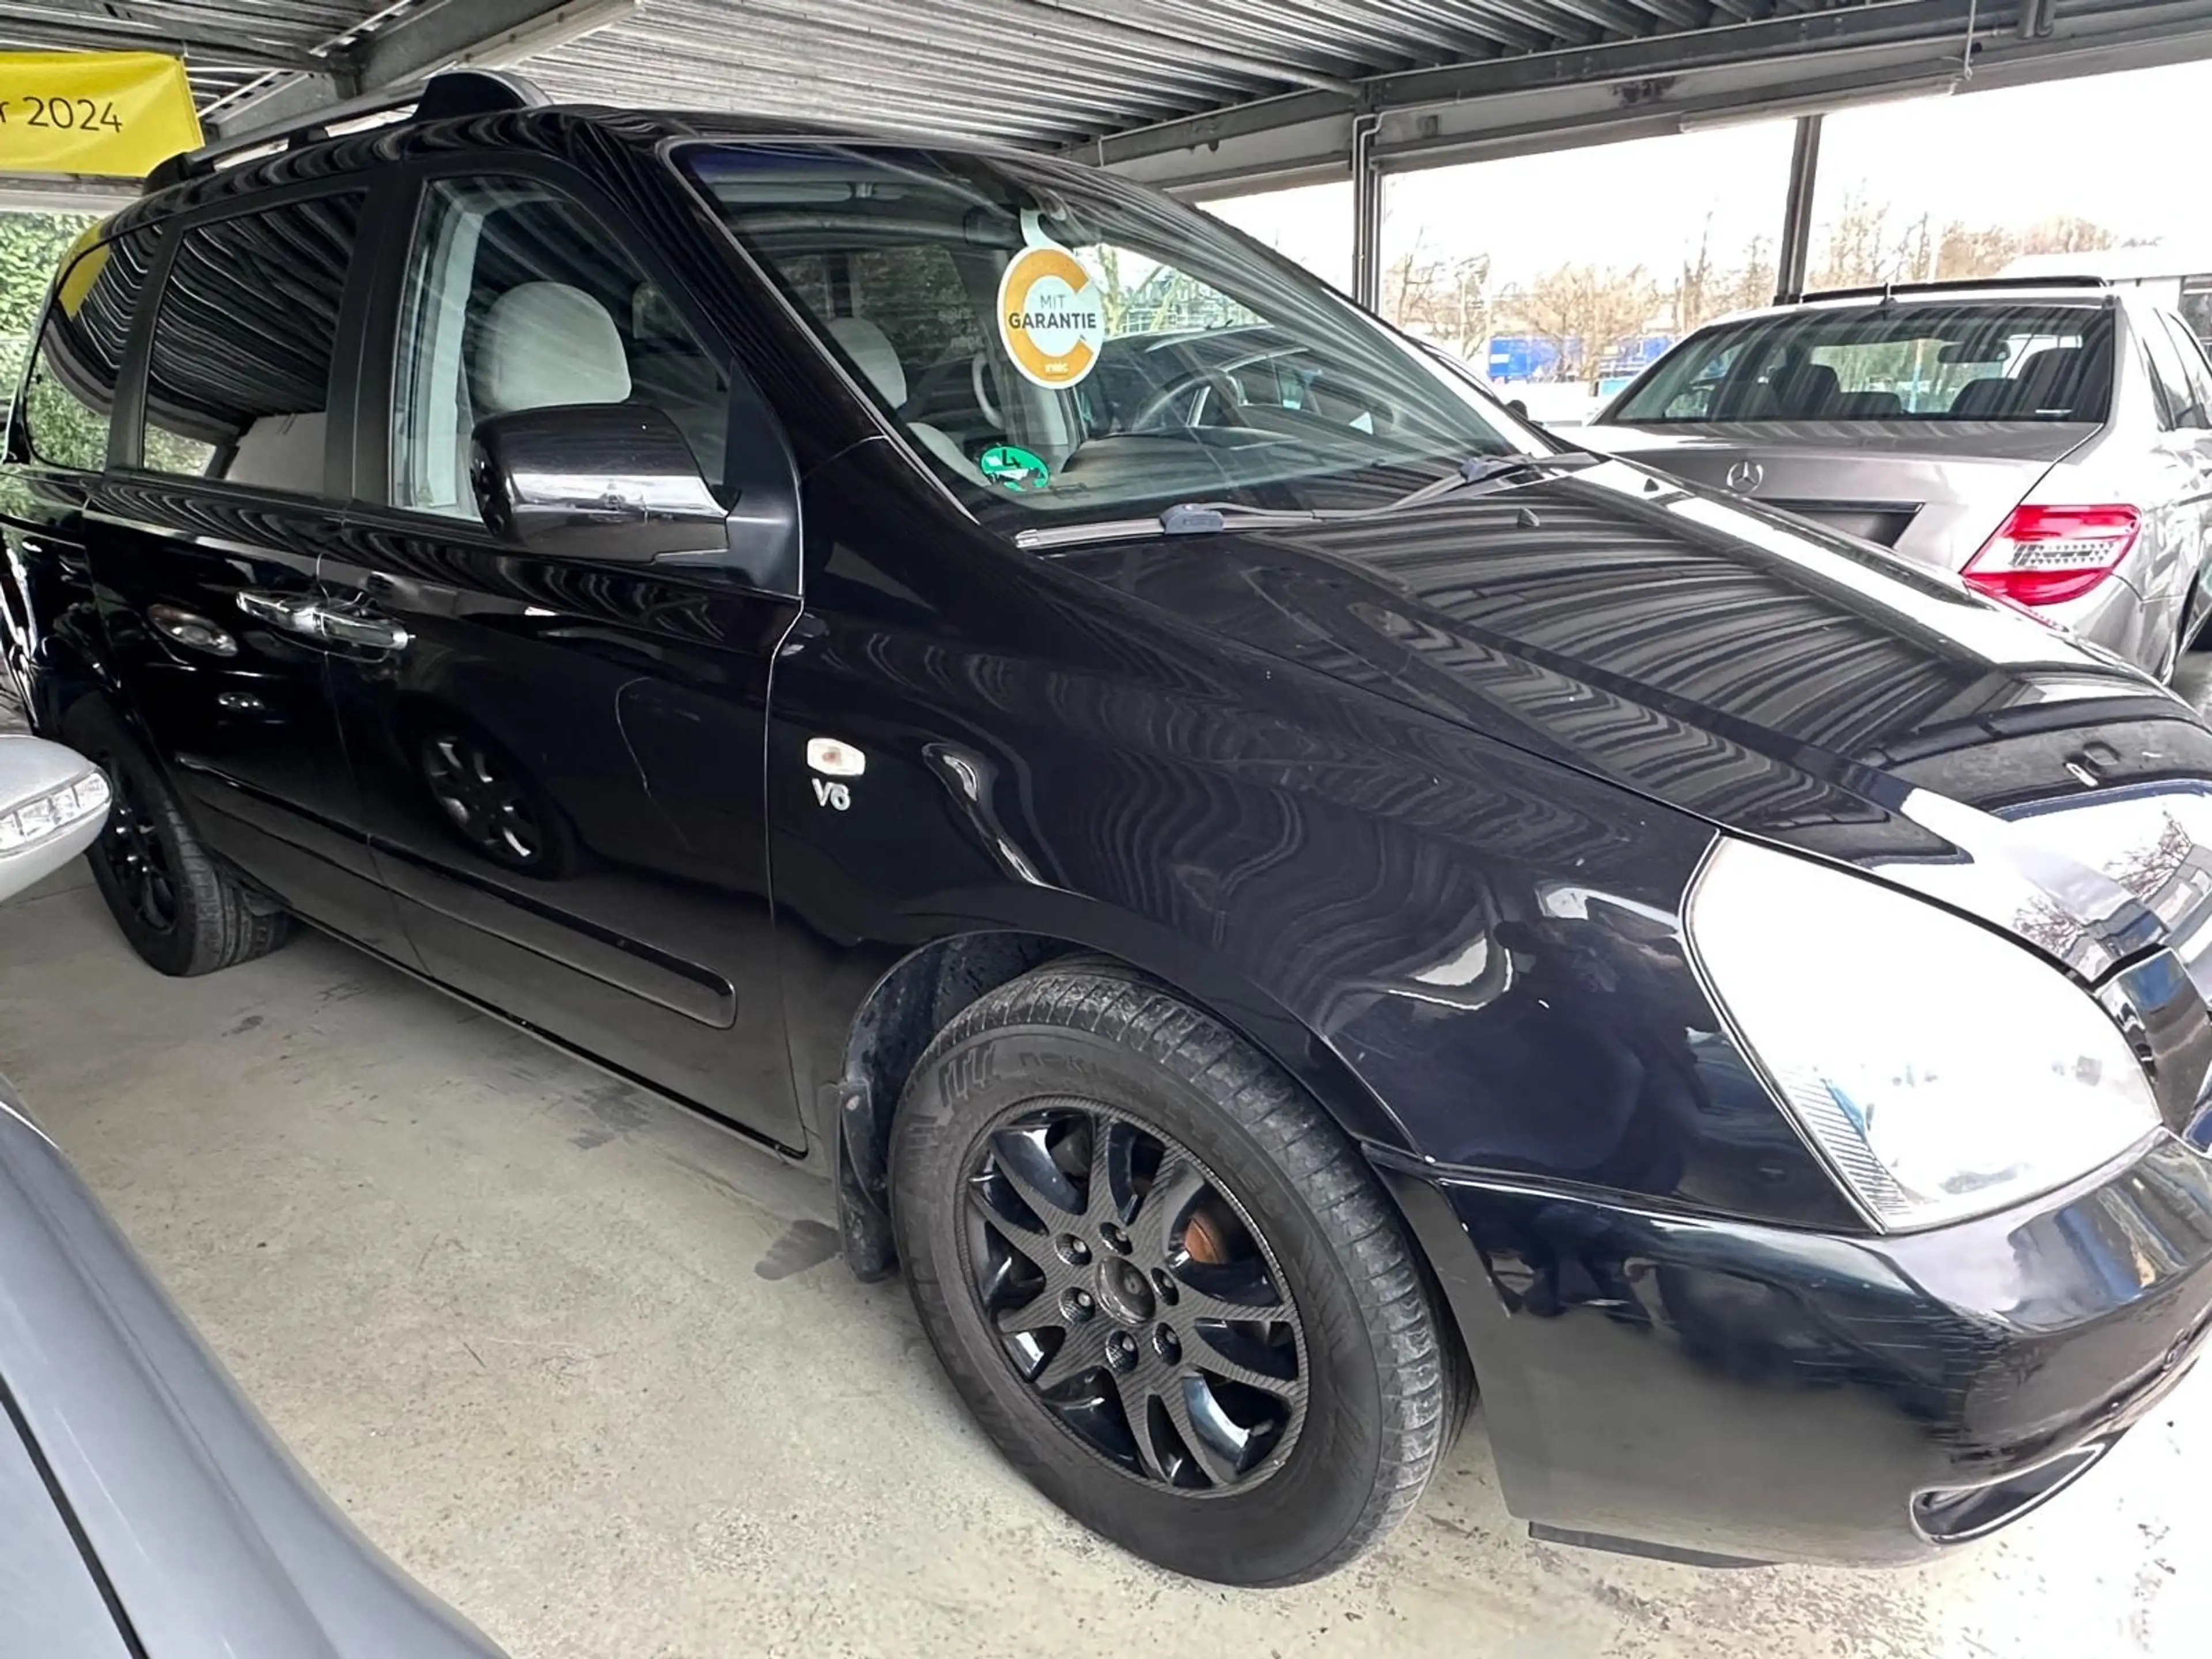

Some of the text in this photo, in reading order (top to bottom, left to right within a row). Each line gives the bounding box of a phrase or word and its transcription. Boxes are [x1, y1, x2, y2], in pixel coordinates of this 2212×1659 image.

[22, 96, 123, 134] 2024
[1040, 294, 1066, 309] MIT
[1009, 312, 1097, 329] GARANTIE
[1002, 449, 1021, 468] 4
[811, 778, 851, 811] V6
